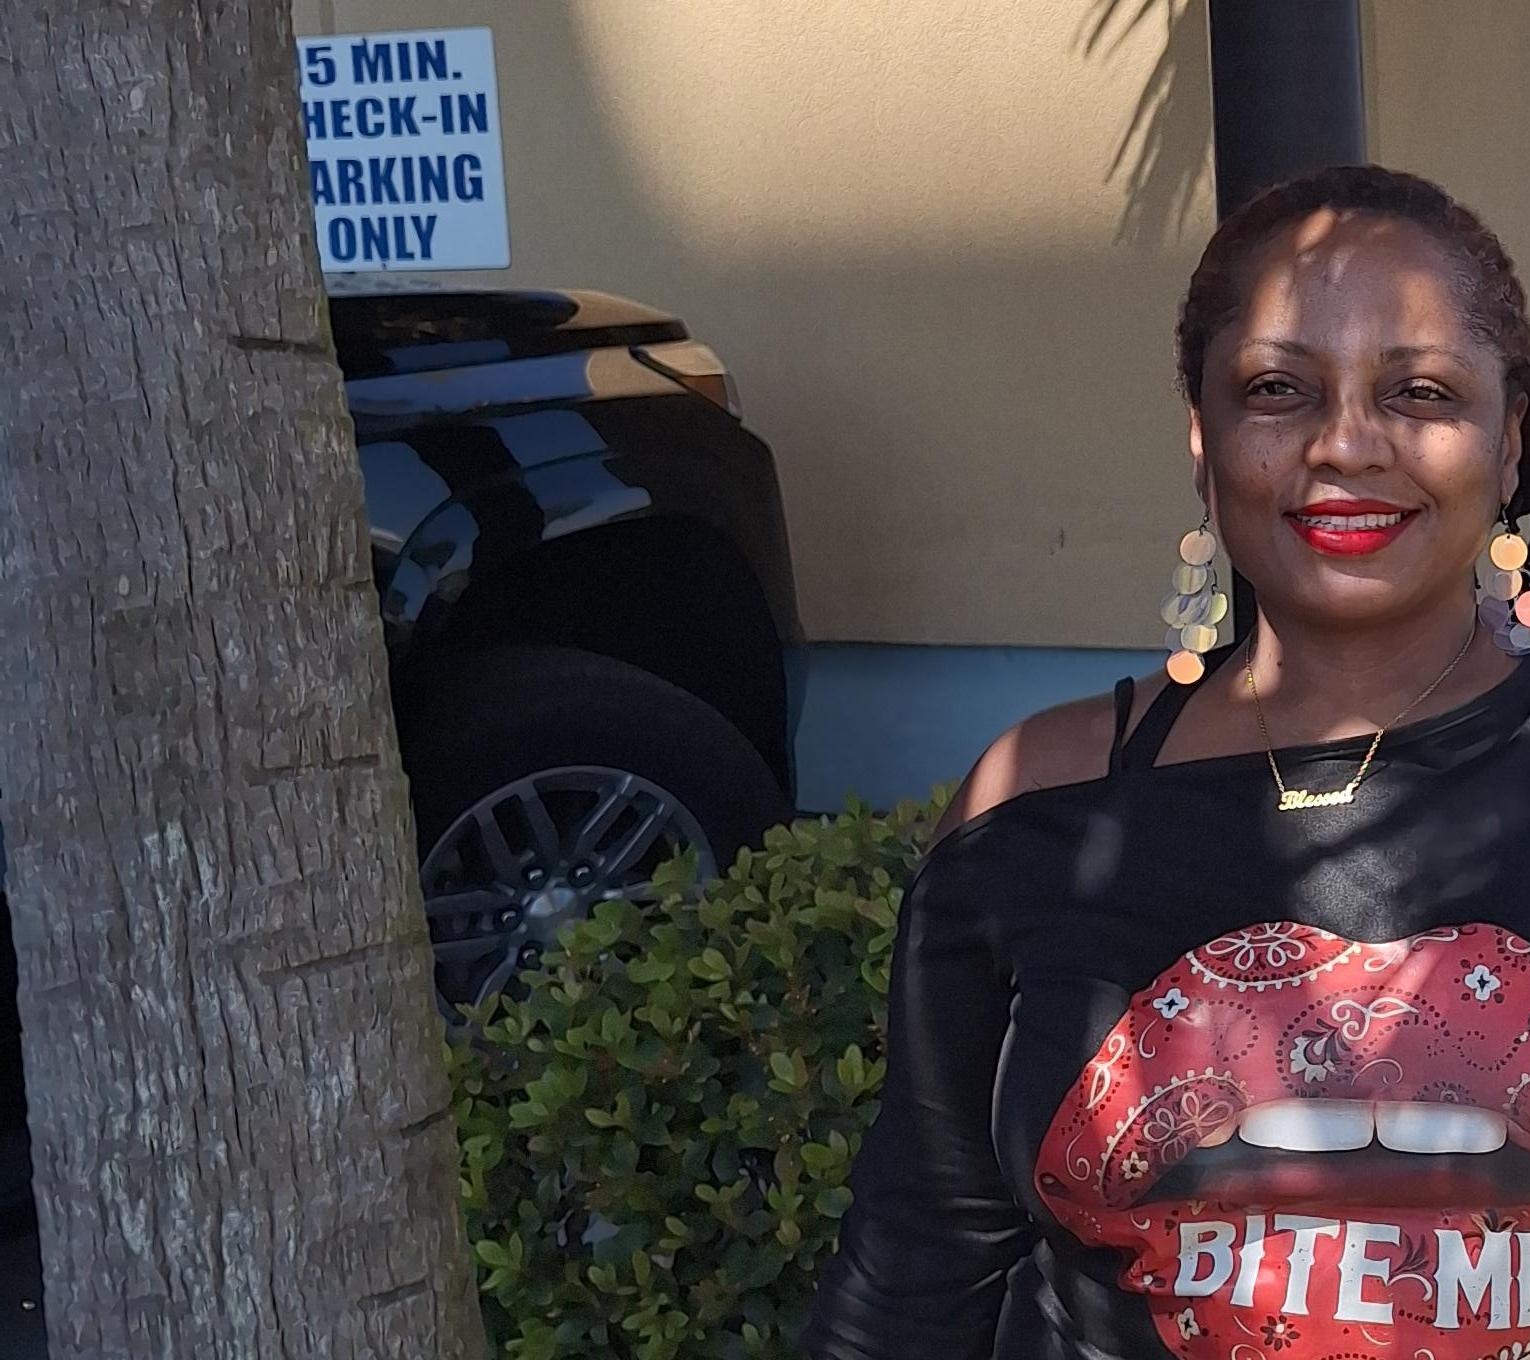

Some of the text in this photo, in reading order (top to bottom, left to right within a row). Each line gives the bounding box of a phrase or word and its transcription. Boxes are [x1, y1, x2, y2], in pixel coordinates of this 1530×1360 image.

[305, 39, 463, 87] 5 MIN.
[302, 92, 489, 140] HECK-IN
[310, 153, 485, 206] ARKING
[328, 214, 437, 262] ONLY
[1173, 1213, 1401, 1327] BITE
